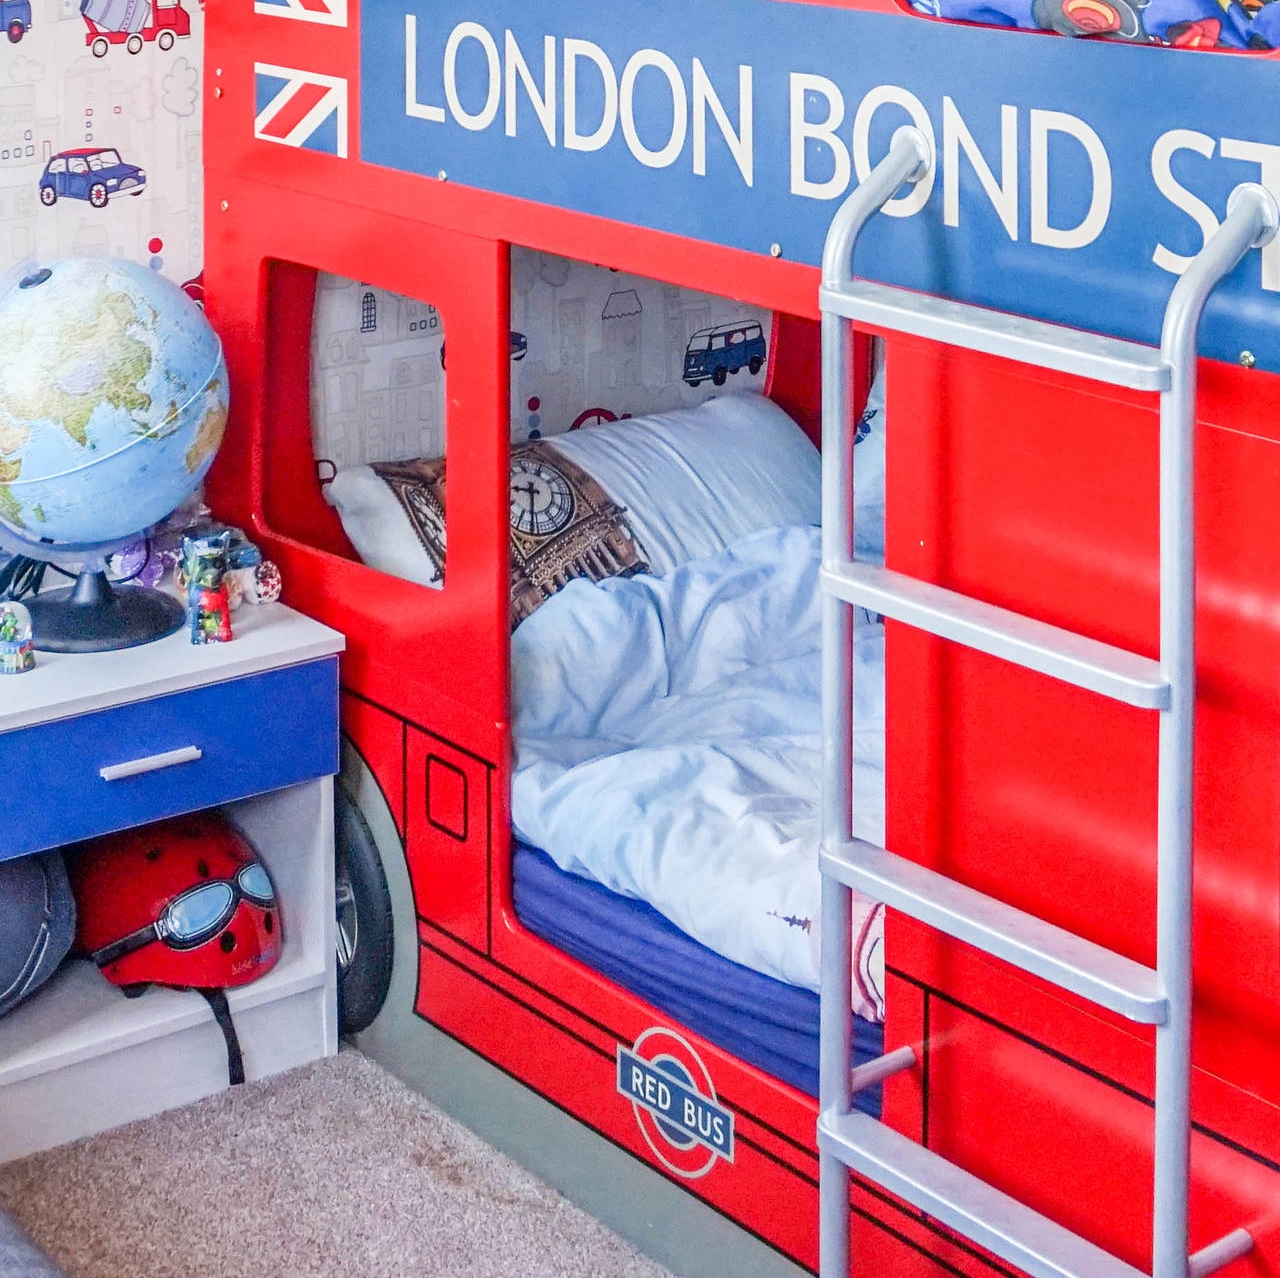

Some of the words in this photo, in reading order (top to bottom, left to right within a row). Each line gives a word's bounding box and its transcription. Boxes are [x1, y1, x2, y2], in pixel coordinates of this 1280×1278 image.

[404, 14, 753, 188] LONDON
[789, 72, 1113, 251] BOND
[631, 1065, 671, 1111] RED
[684, 1097, 725, 1145] BUS
